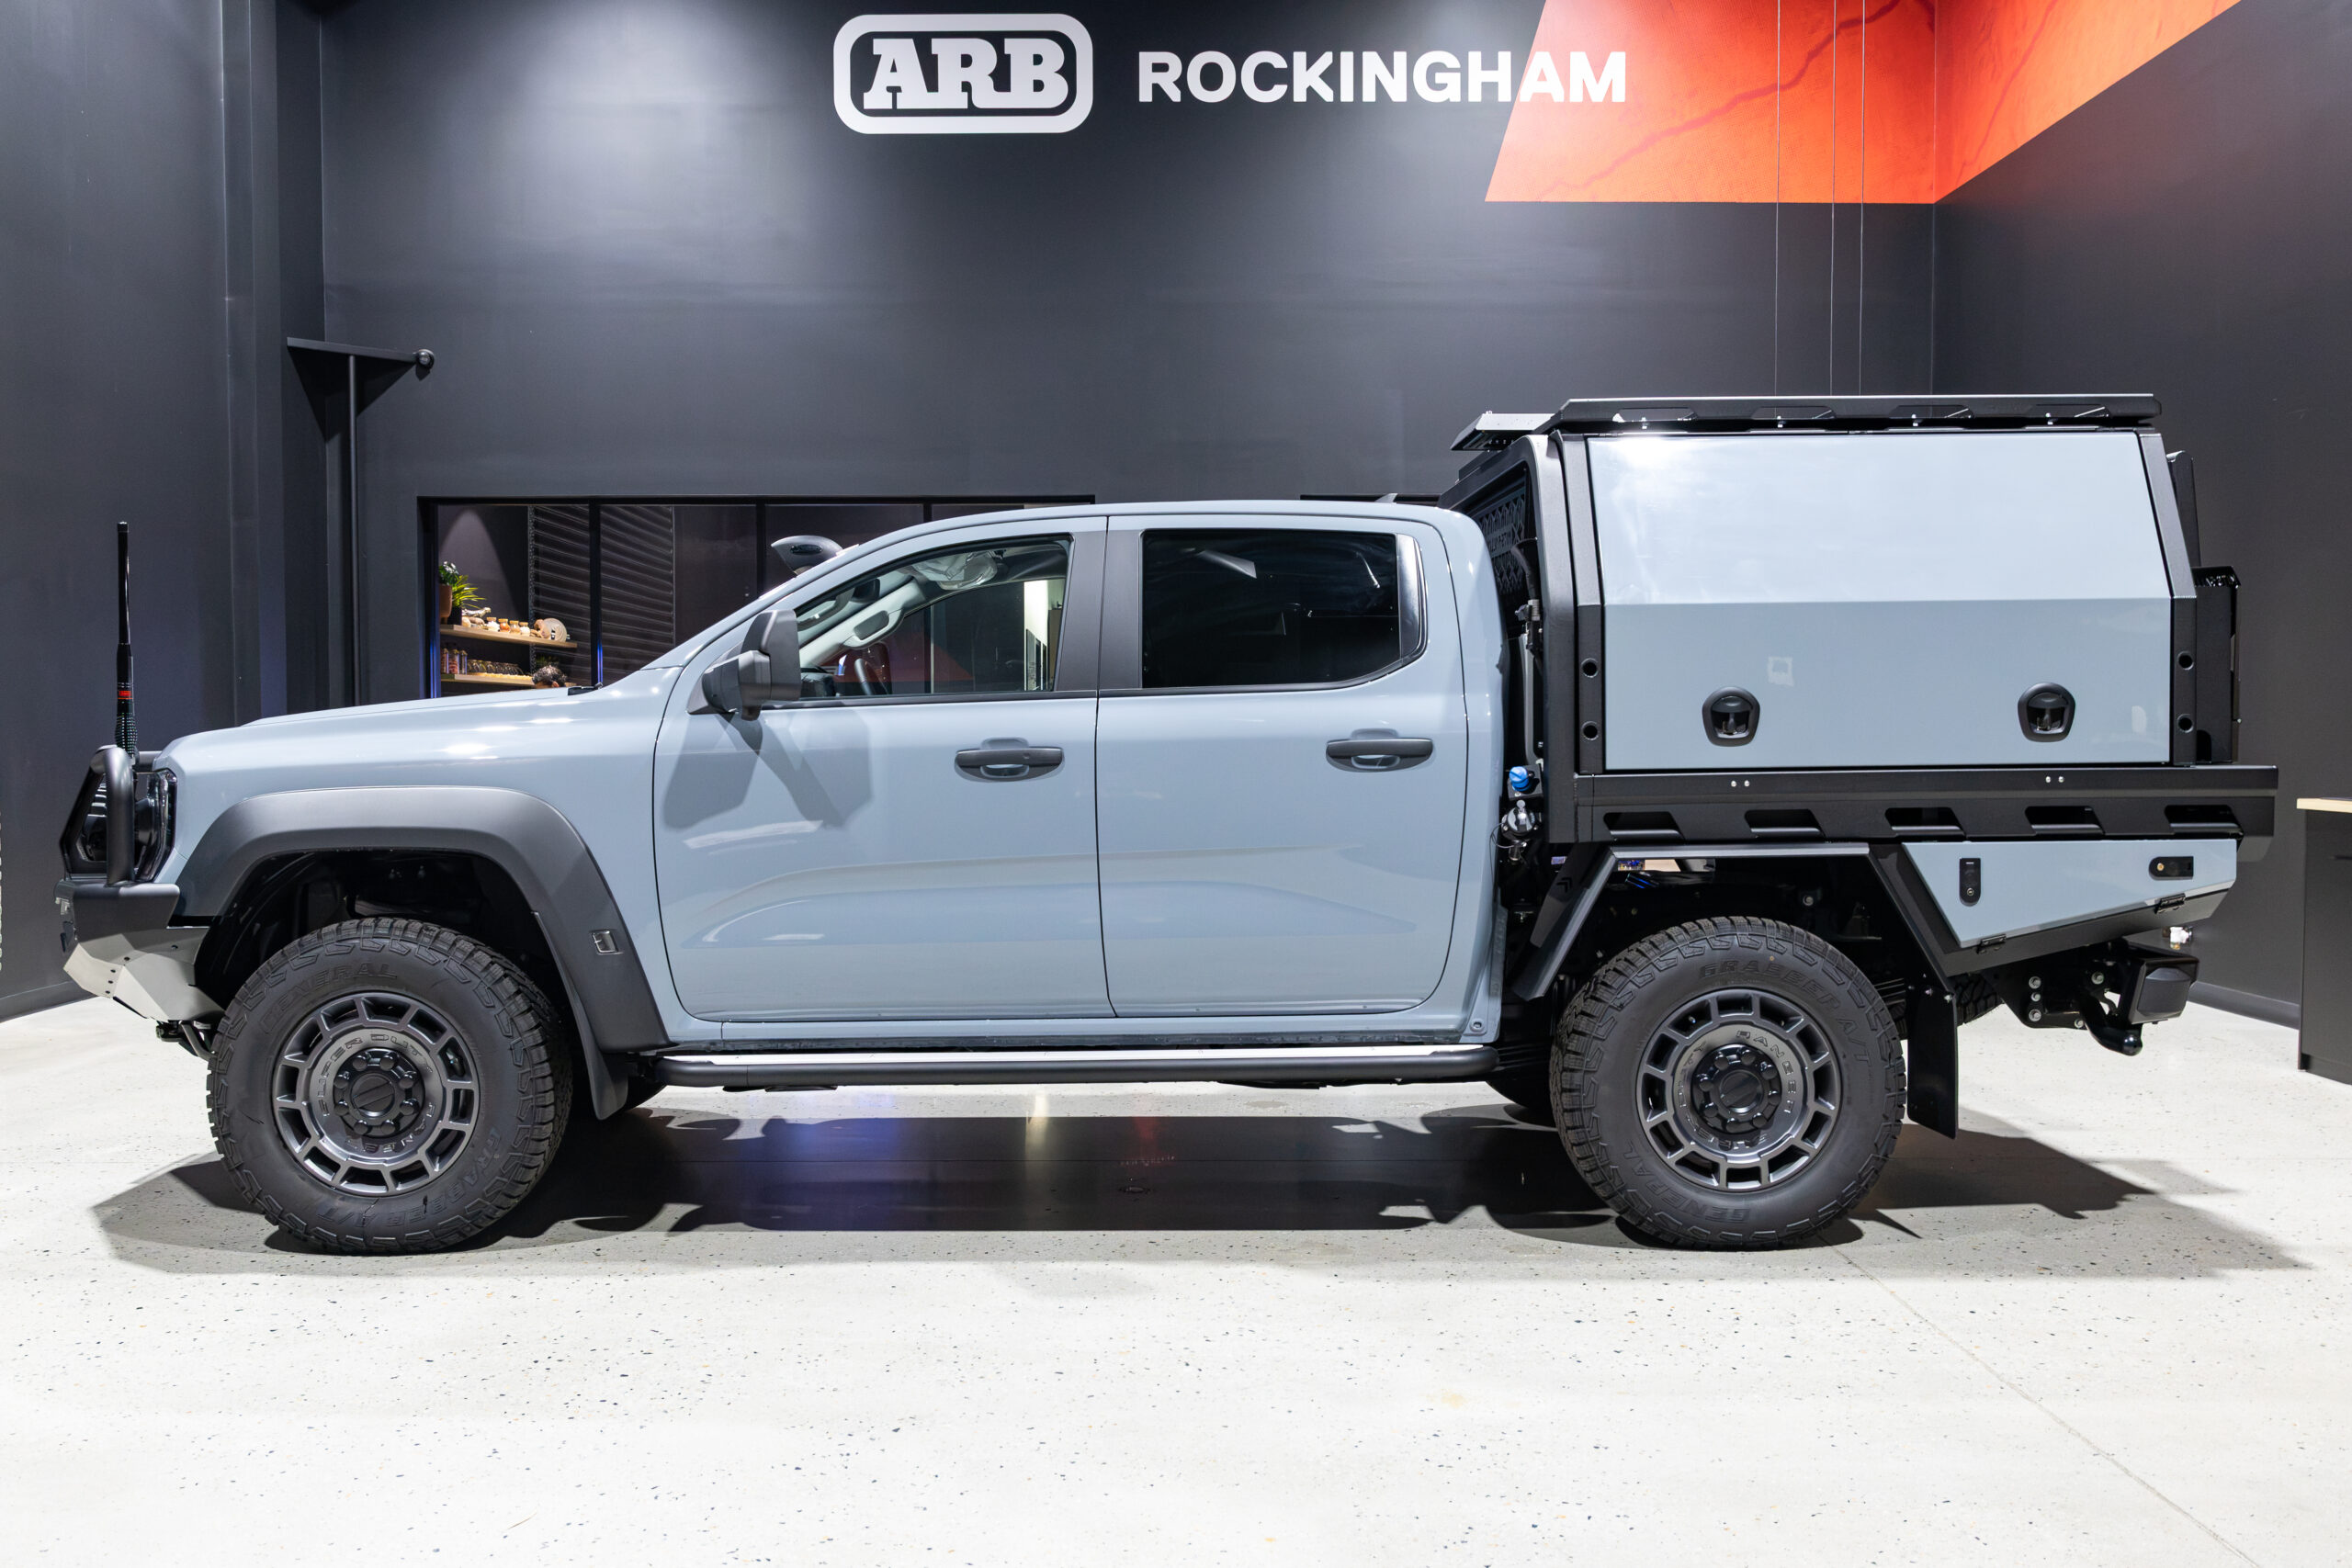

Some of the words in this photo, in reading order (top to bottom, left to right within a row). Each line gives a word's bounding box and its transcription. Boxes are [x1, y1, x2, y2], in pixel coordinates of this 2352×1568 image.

[864, 38, 1069, 109] ARB
[1138, 51, 1627, 103] ROCKINGHAM
[259, 963, 398, 1033] GENERAL
[1700, 960, 1841, 1012] GRABBER
[1837, 1018, 1871, 1067] A/T
[1736, 1030, 1796, 1113] RANGER
[1623, 1141, 1751, 1224] GENERAL
